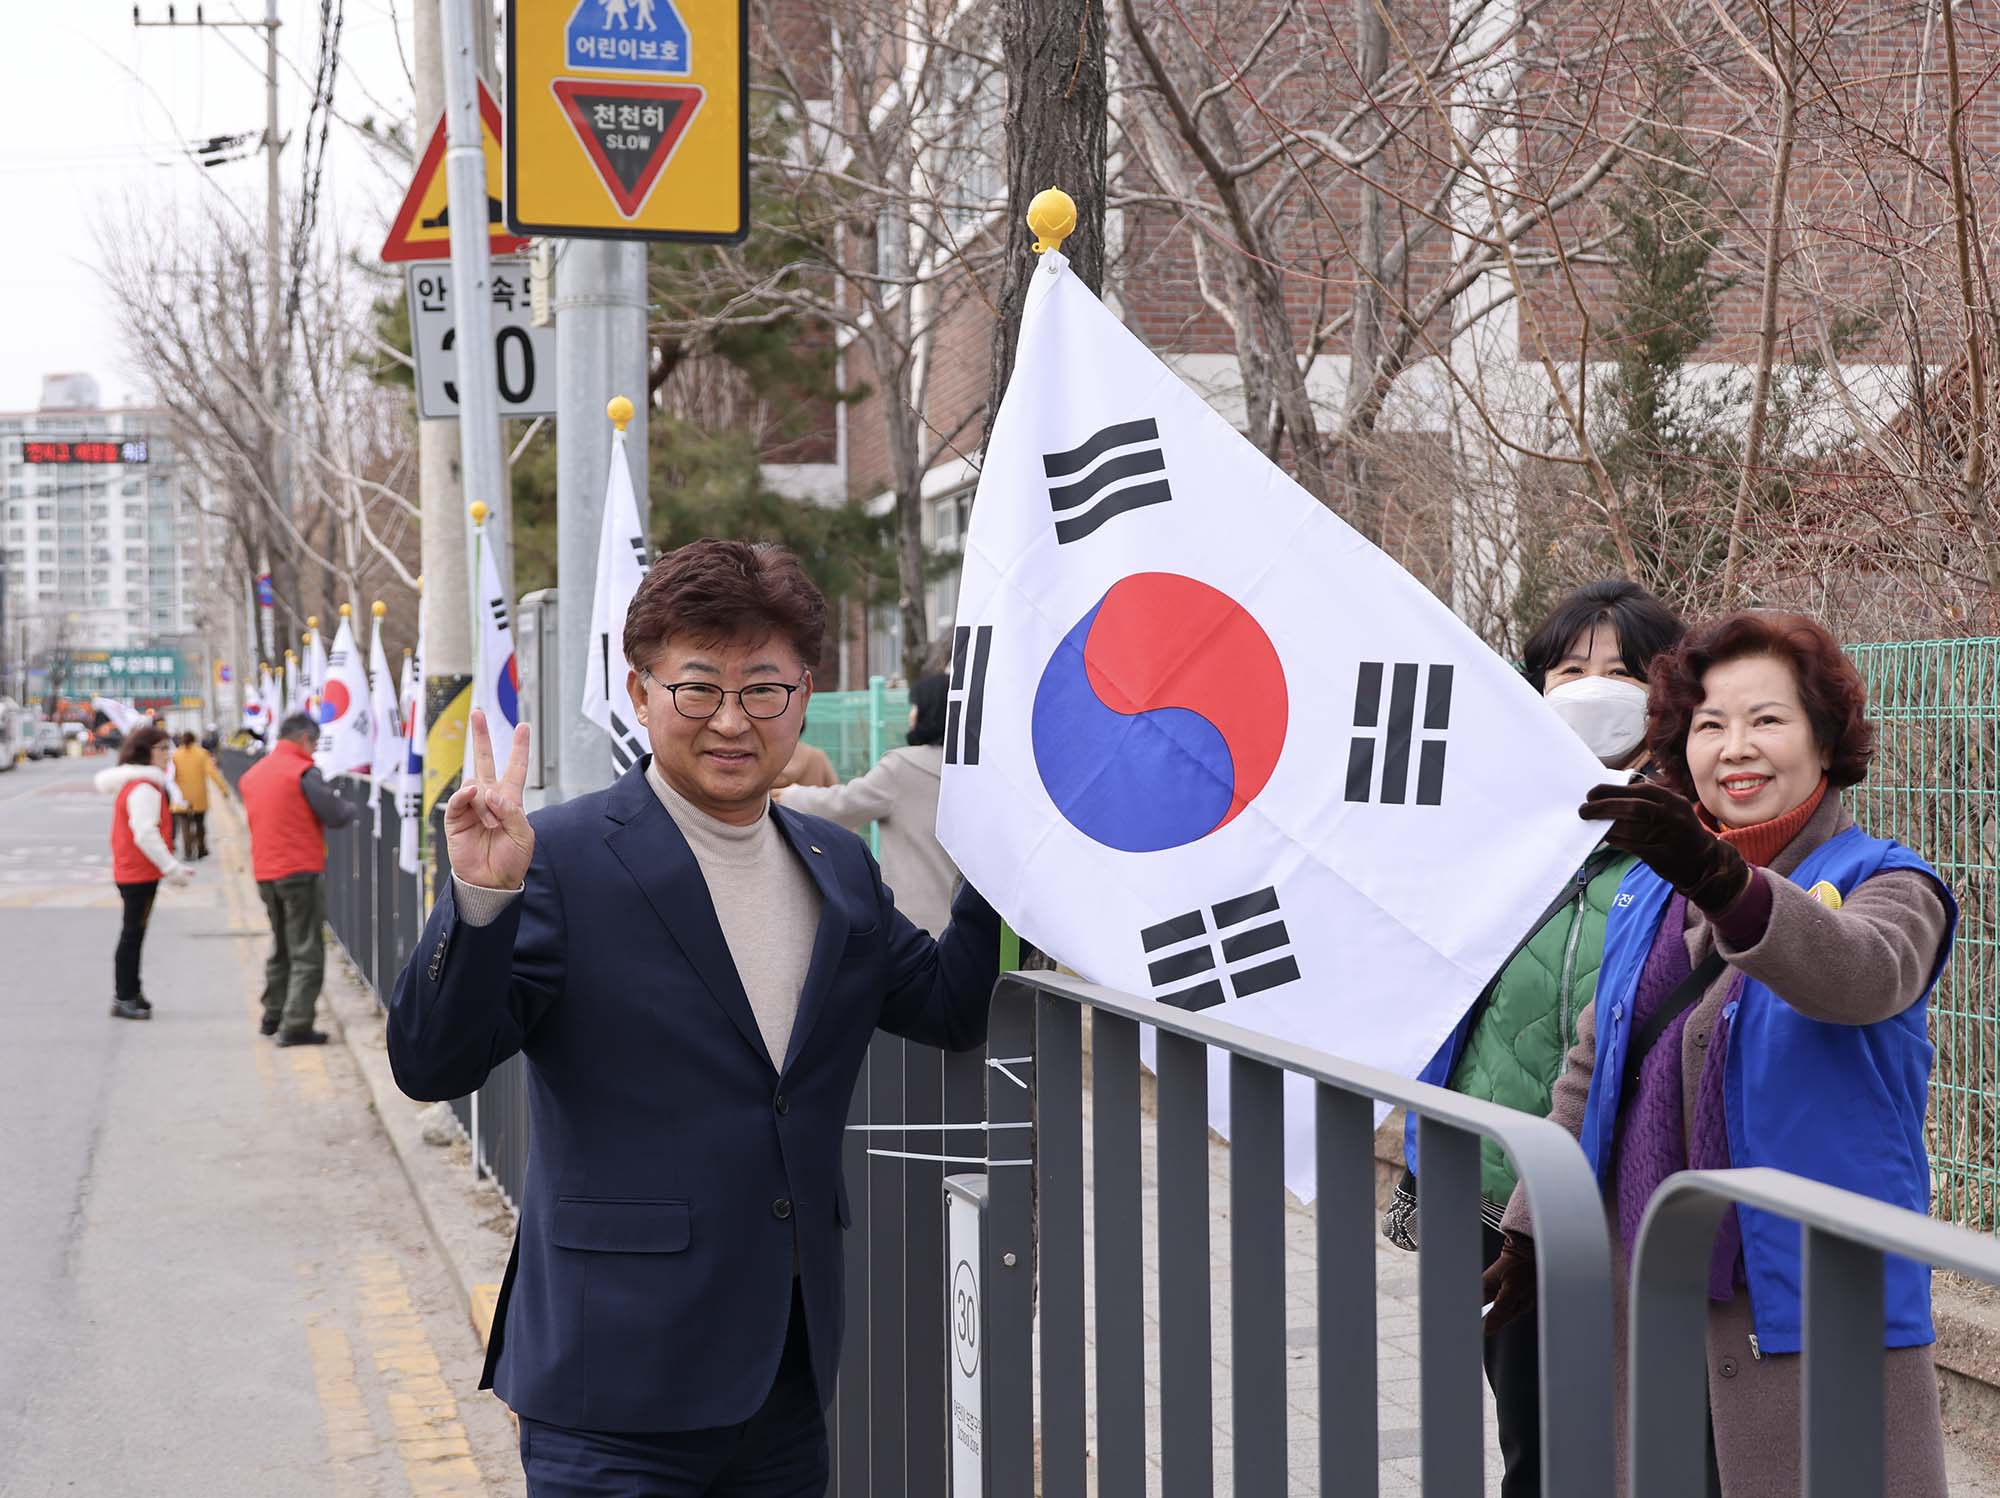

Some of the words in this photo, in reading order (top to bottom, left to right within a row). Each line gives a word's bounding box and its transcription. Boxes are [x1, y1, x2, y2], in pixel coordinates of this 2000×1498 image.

[575, 35, 681, 62] 어린이보호
[593, 104, 665, 132] 천천히
[606, 134, 651, 151] SLOW
[957, 1289, 975, 1348] 30
